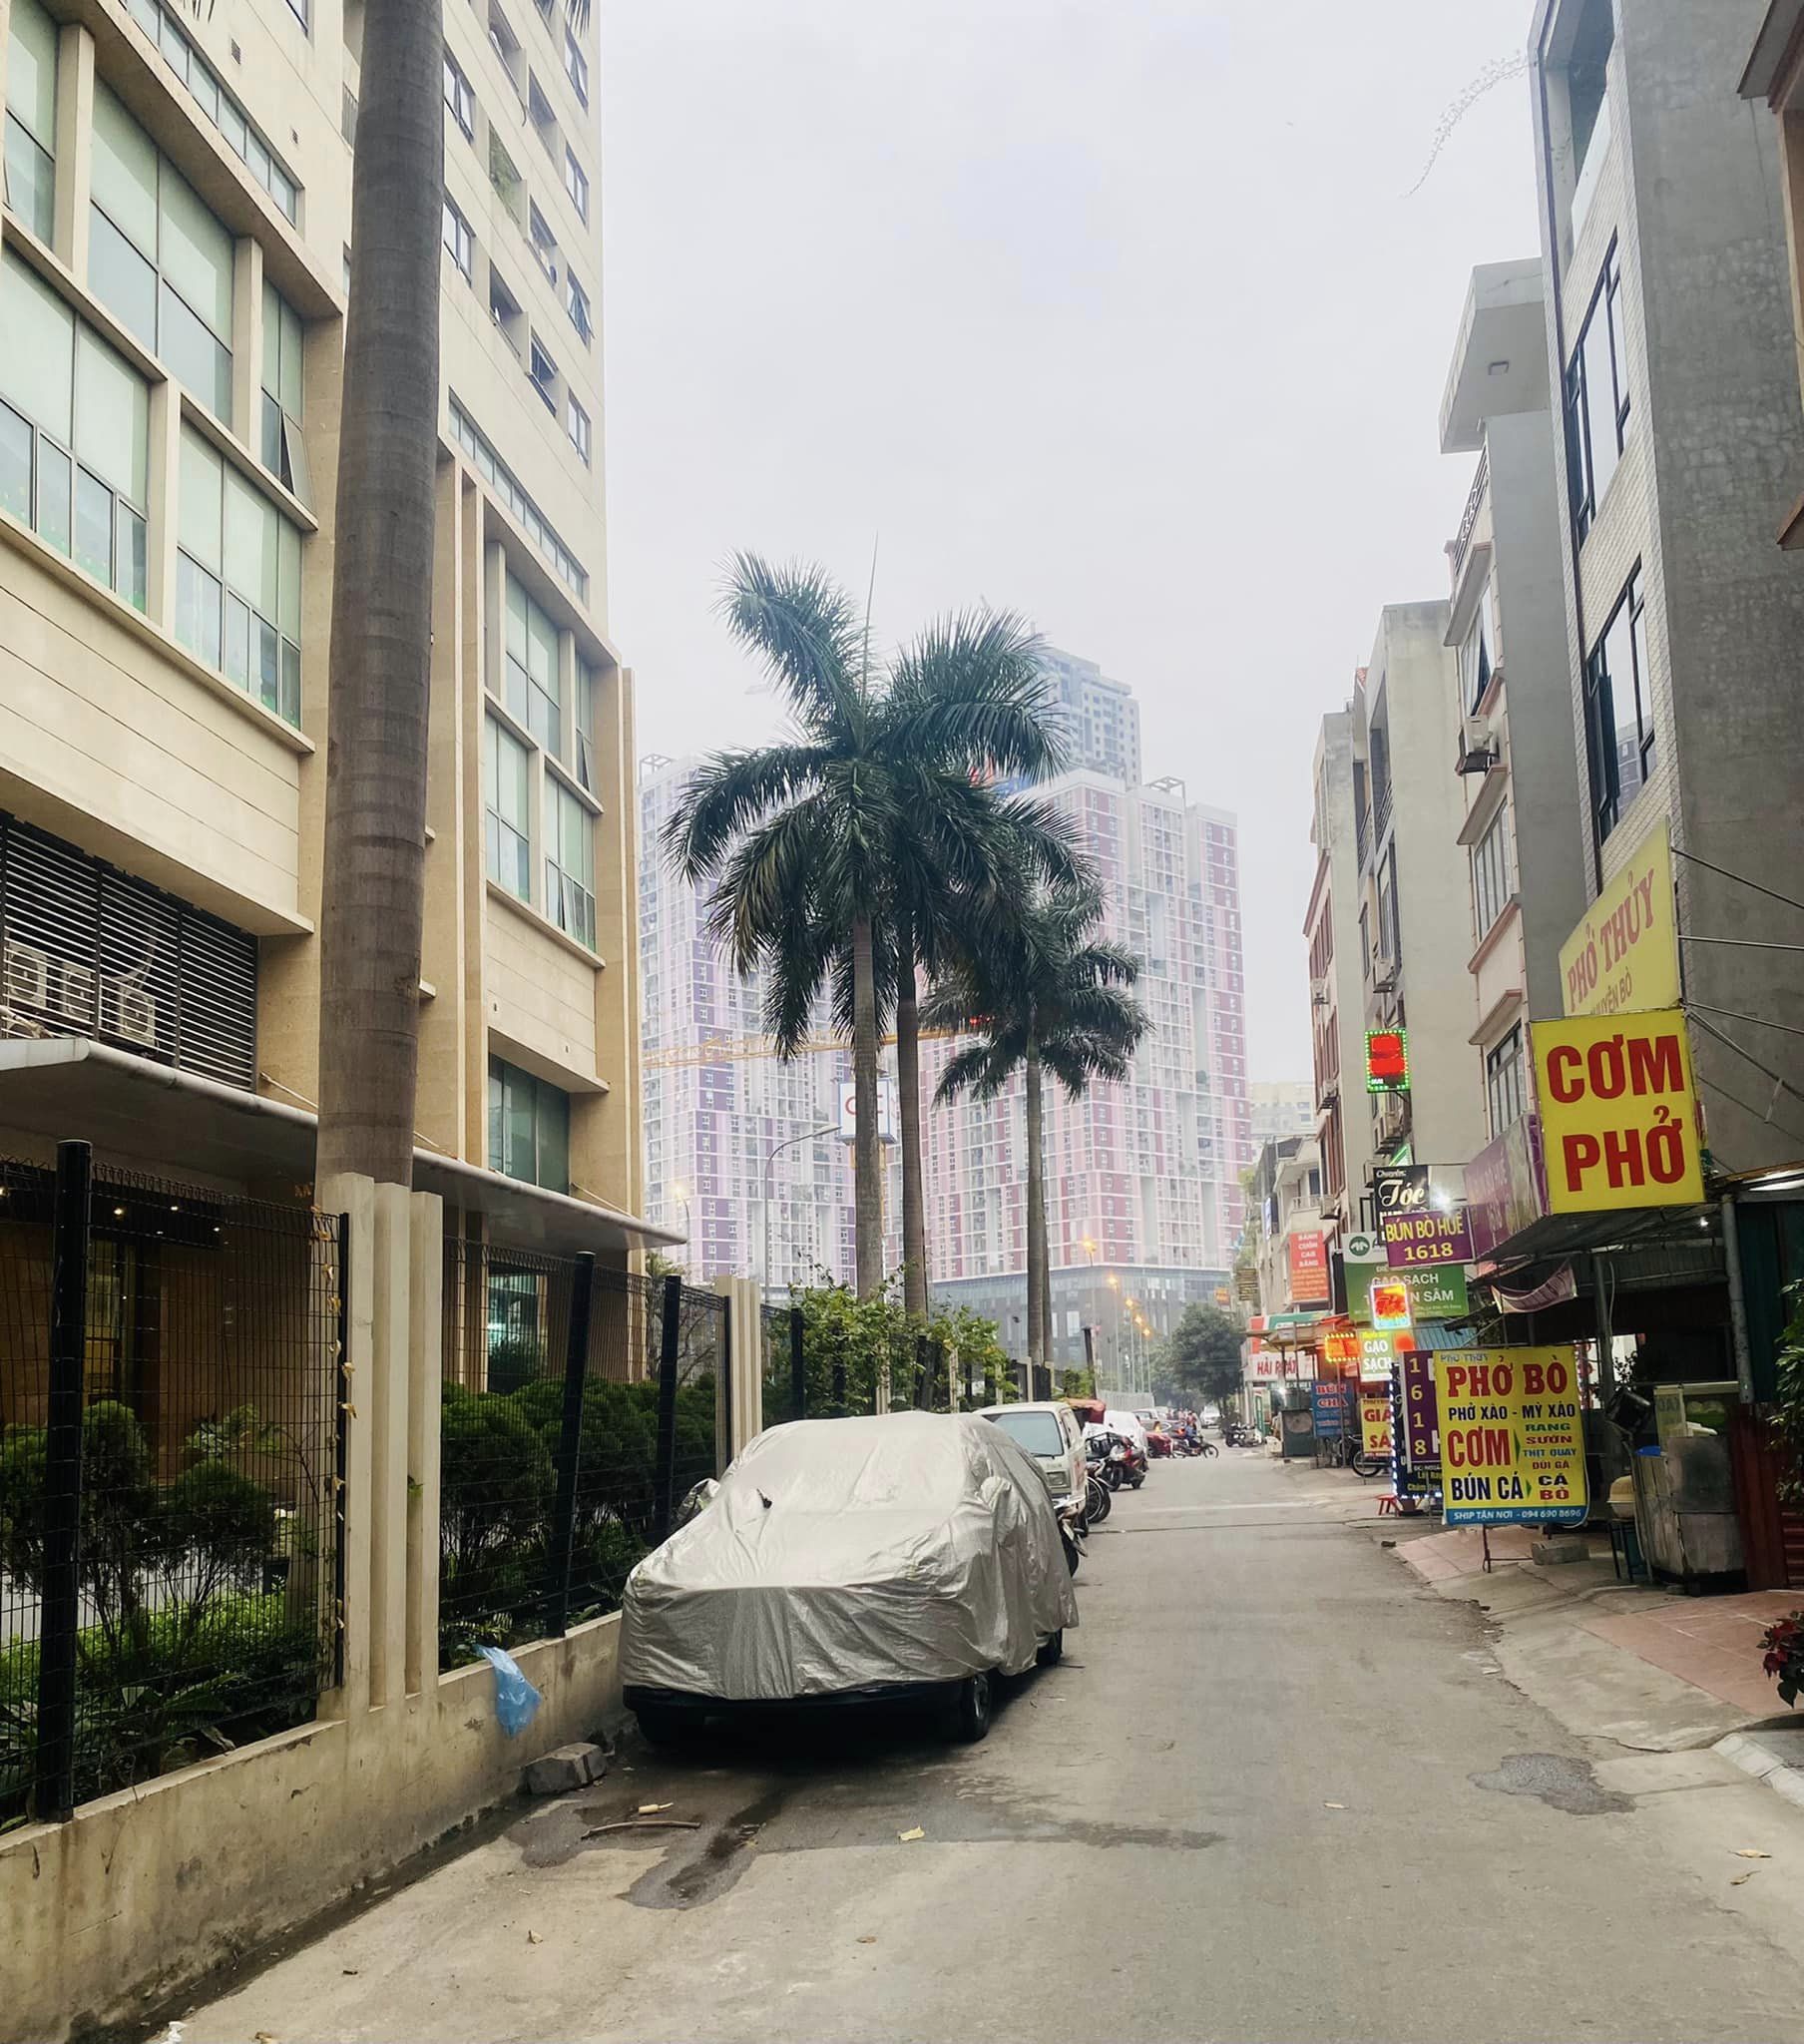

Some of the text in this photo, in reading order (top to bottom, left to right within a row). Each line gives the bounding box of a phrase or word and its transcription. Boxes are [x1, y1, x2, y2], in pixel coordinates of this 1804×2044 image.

[1547, 1034, 1684, 1103] CƠM
[1562, 1105, 1685, 1193] PHỞ
[1385, 1218, 1415, 1243] BÚN
[1415, 1214, 1435, 1239] BÒ
[1404, 1242, 1455, 1262] 1618
[1402, 1272, 1439, 1286] SẠCH
[1423, 1287, 1454, 1302] SÂM
[1363, 1339, 1389, 1355] GẠO
[1257, 1357, 1272, 1375] HẢI
[1447, 1354, 1568, 1398] PHỞ BÒ
[1449, 1401, 1477, 1421] PHỞ
[1481, 1400, 1508, 1419] XÀO
[1525, 1422, 1572, 1432] RANG
[1448, 1425, 1511, 1468] CƠM
[1451, 1470, 1524, 1501] BÚN CÁ
[1538, 1472, 1569, 1486] CÁ
[1540, 1486, 1570, 1500] BÒ
[1454, 1510, 1475, 1520] SHIP
[1541, 1509, 1558, 1518] 690
[1559, 1508, 1581, 1517] 8696
